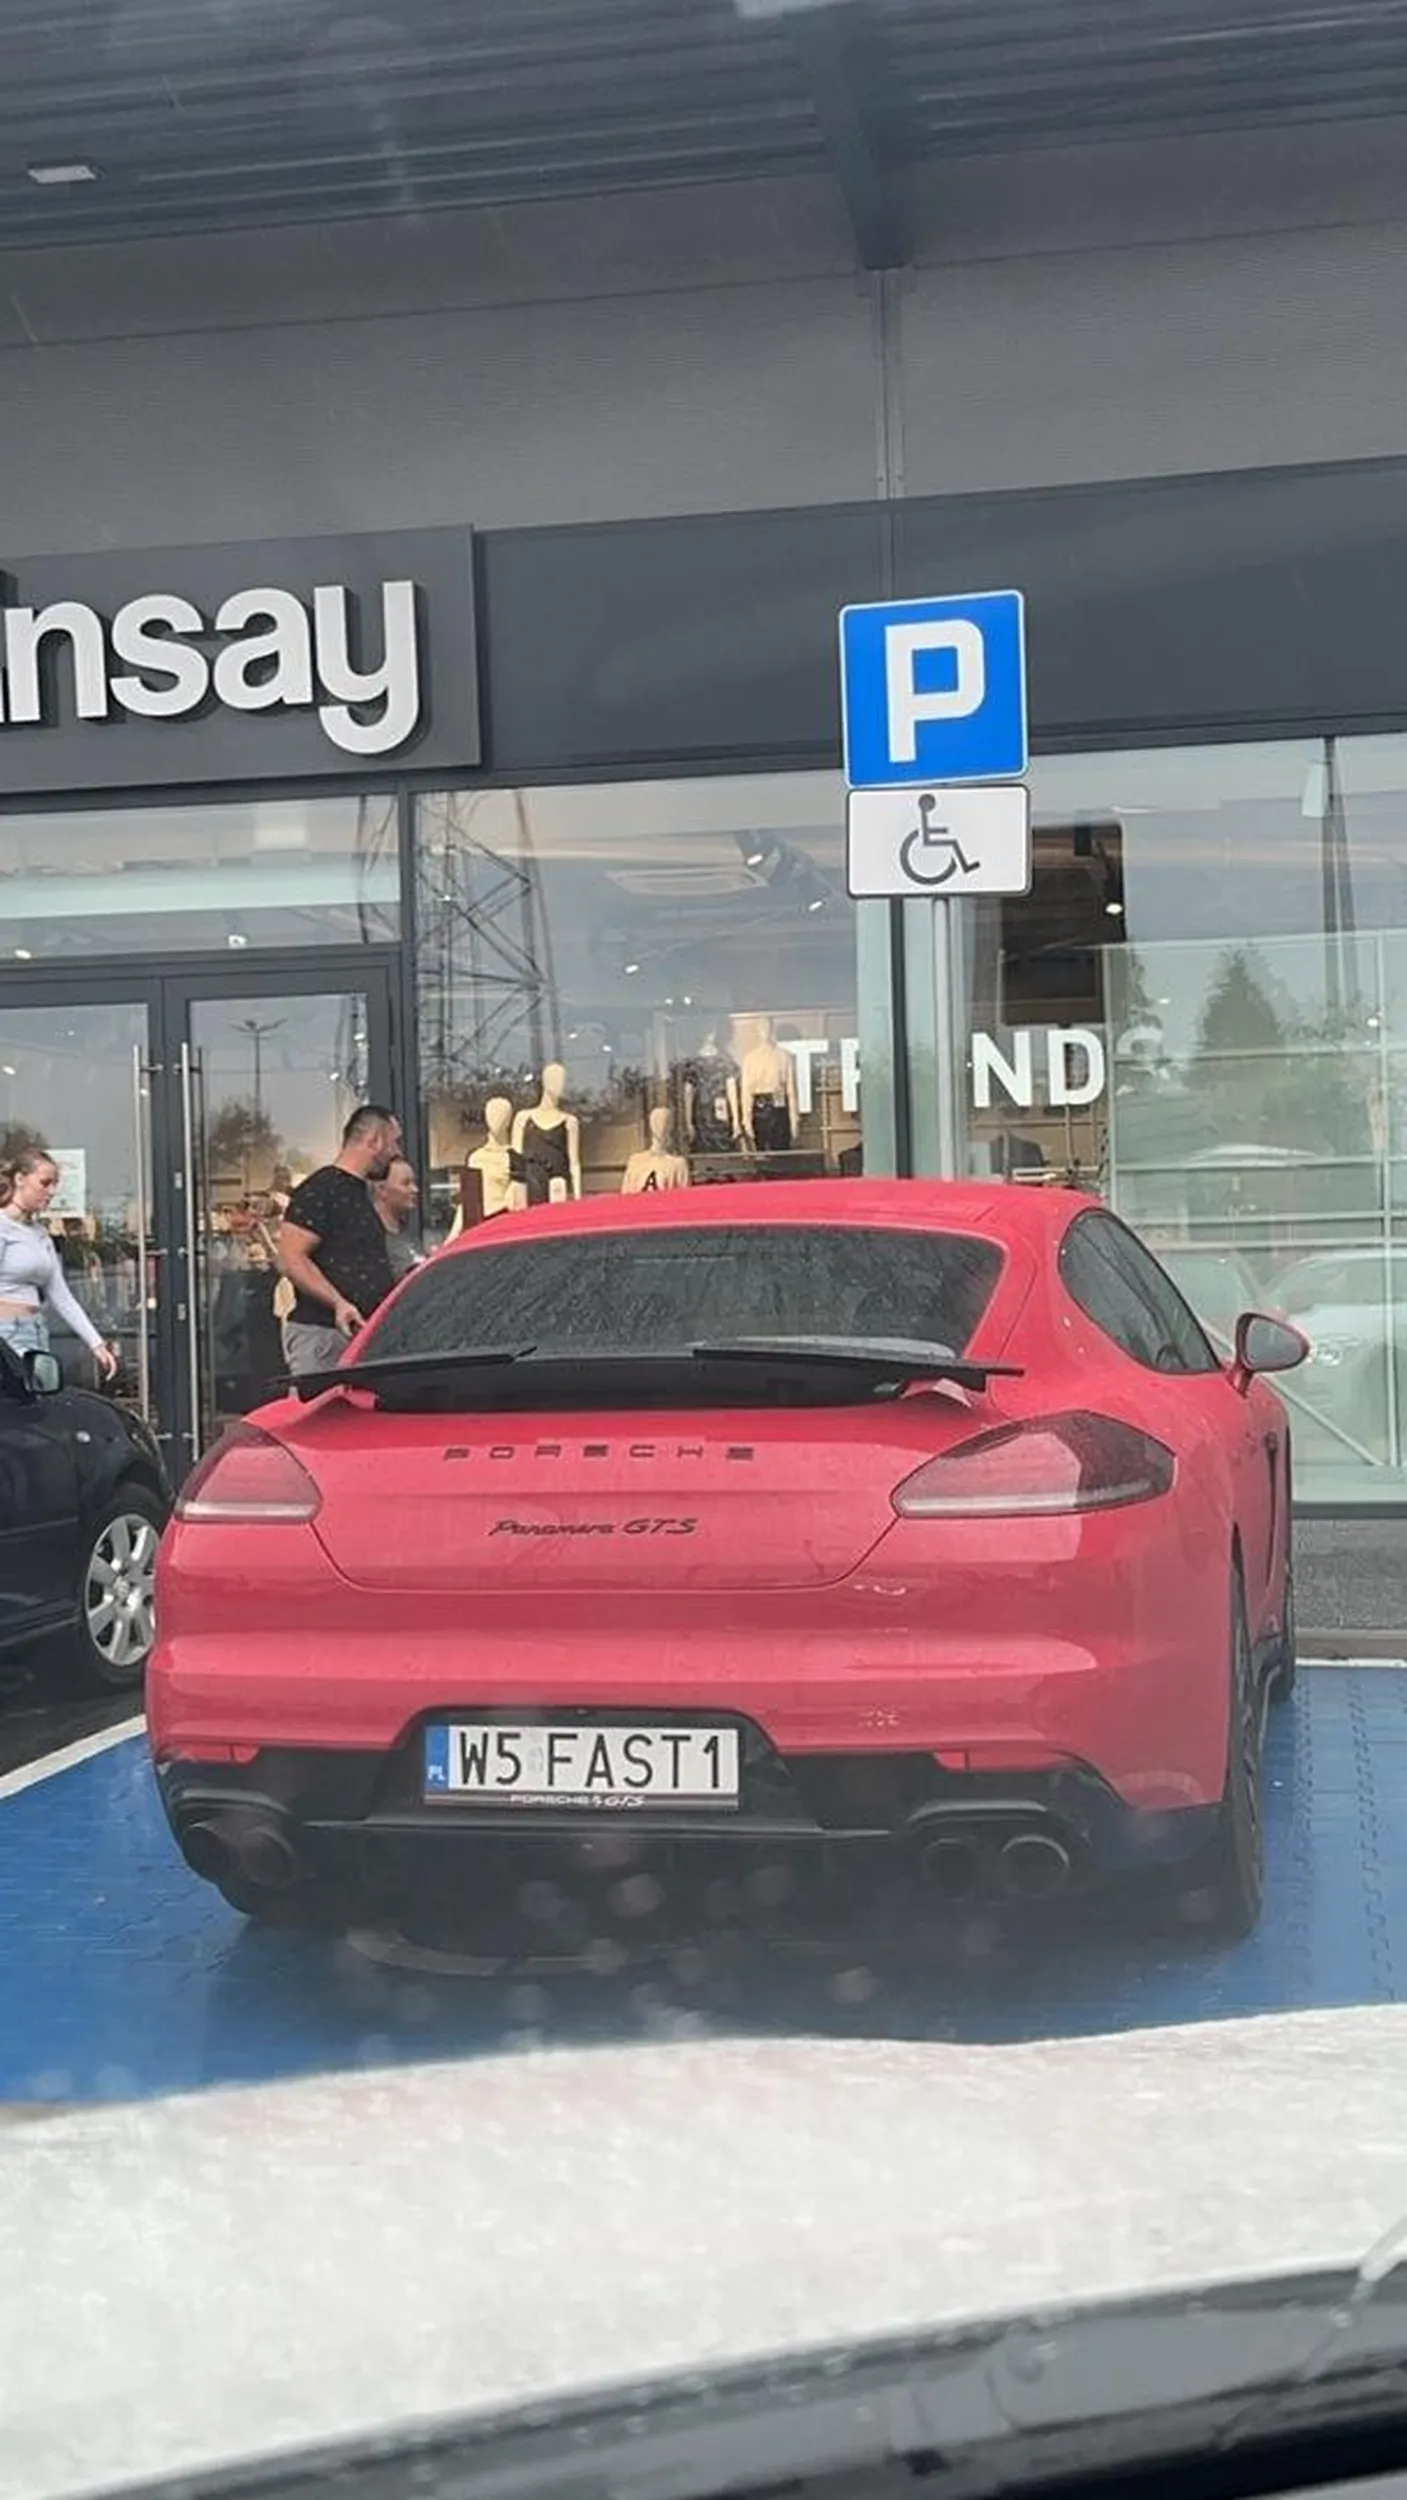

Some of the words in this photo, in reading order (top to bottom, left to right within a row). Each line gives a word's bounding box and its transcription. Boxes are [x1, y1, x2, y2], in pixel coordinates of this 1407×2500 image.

[0, 580, 419, 754] nsay
[885, 619, 985, 763] P
[443, 1444, 755, 1461] PORSCHE
[488, 1519, 616, 1537] Panamera
[623, 1518, 698, 1536] GTS
[427, 1764, 445, 1781] PL
[459, 1732, 522, 1786] W5
[547, 1733, 720, 1789] FAST1
